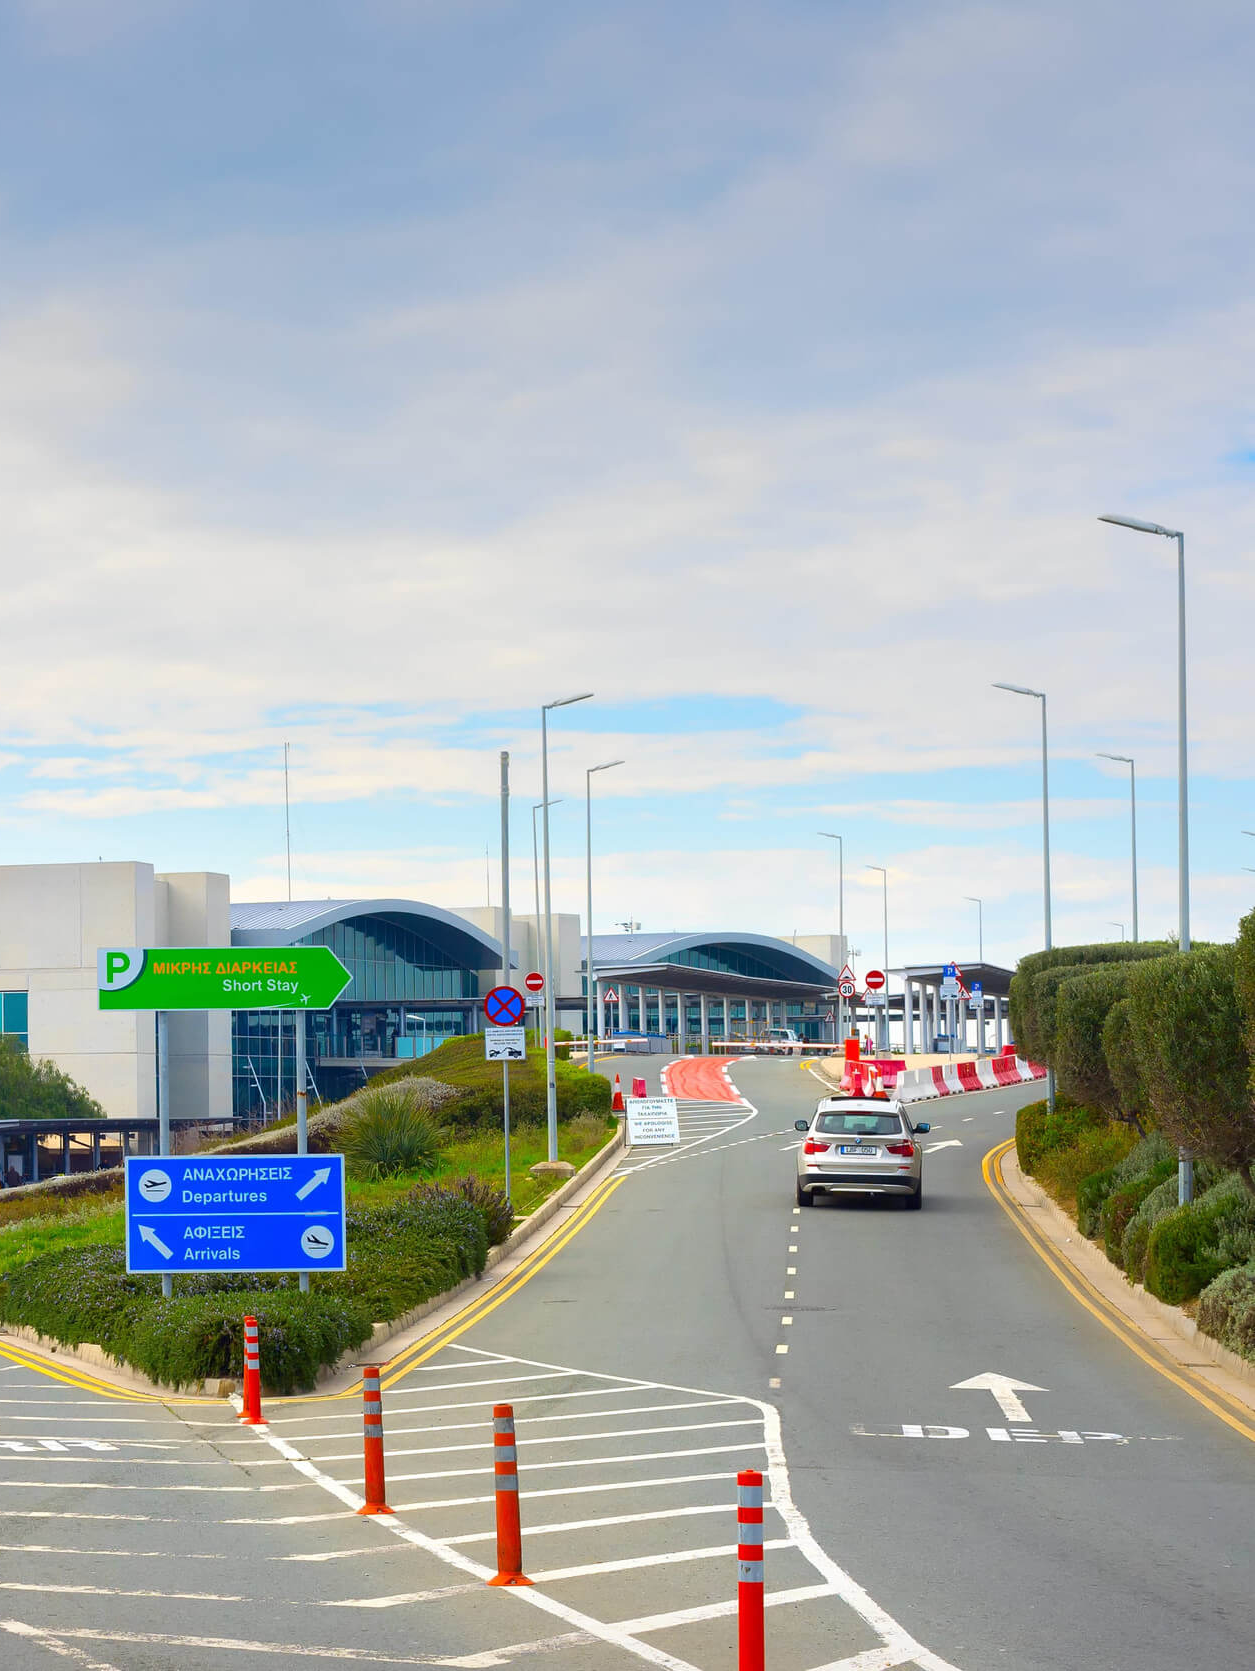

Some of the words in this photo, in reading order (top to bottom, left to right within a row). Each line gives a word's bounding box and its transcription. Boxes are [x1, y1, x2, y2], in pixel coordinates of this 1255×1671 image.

[106, 952, 130, 983] P
[153, 962, 212, 975] ΜΙΚΡΗΣ
[215, 961, 298, 975] ΔΙΑΡΚΕΙΑΣ
[222, 979, 262, 992] Short
[266, 979, 299, 994] Stay
[842, 985, 852, 994] 30
[183, 1167, 293, 1181] ΑΝΑΧΩΡΗΣΕΙΣ
[182, 1190, 268, 1205] Departures
[184, 1226, 245, 1239] ΑΦΙΞΕΙΣ
[184, 1247, 241, 1260] Arrivals
